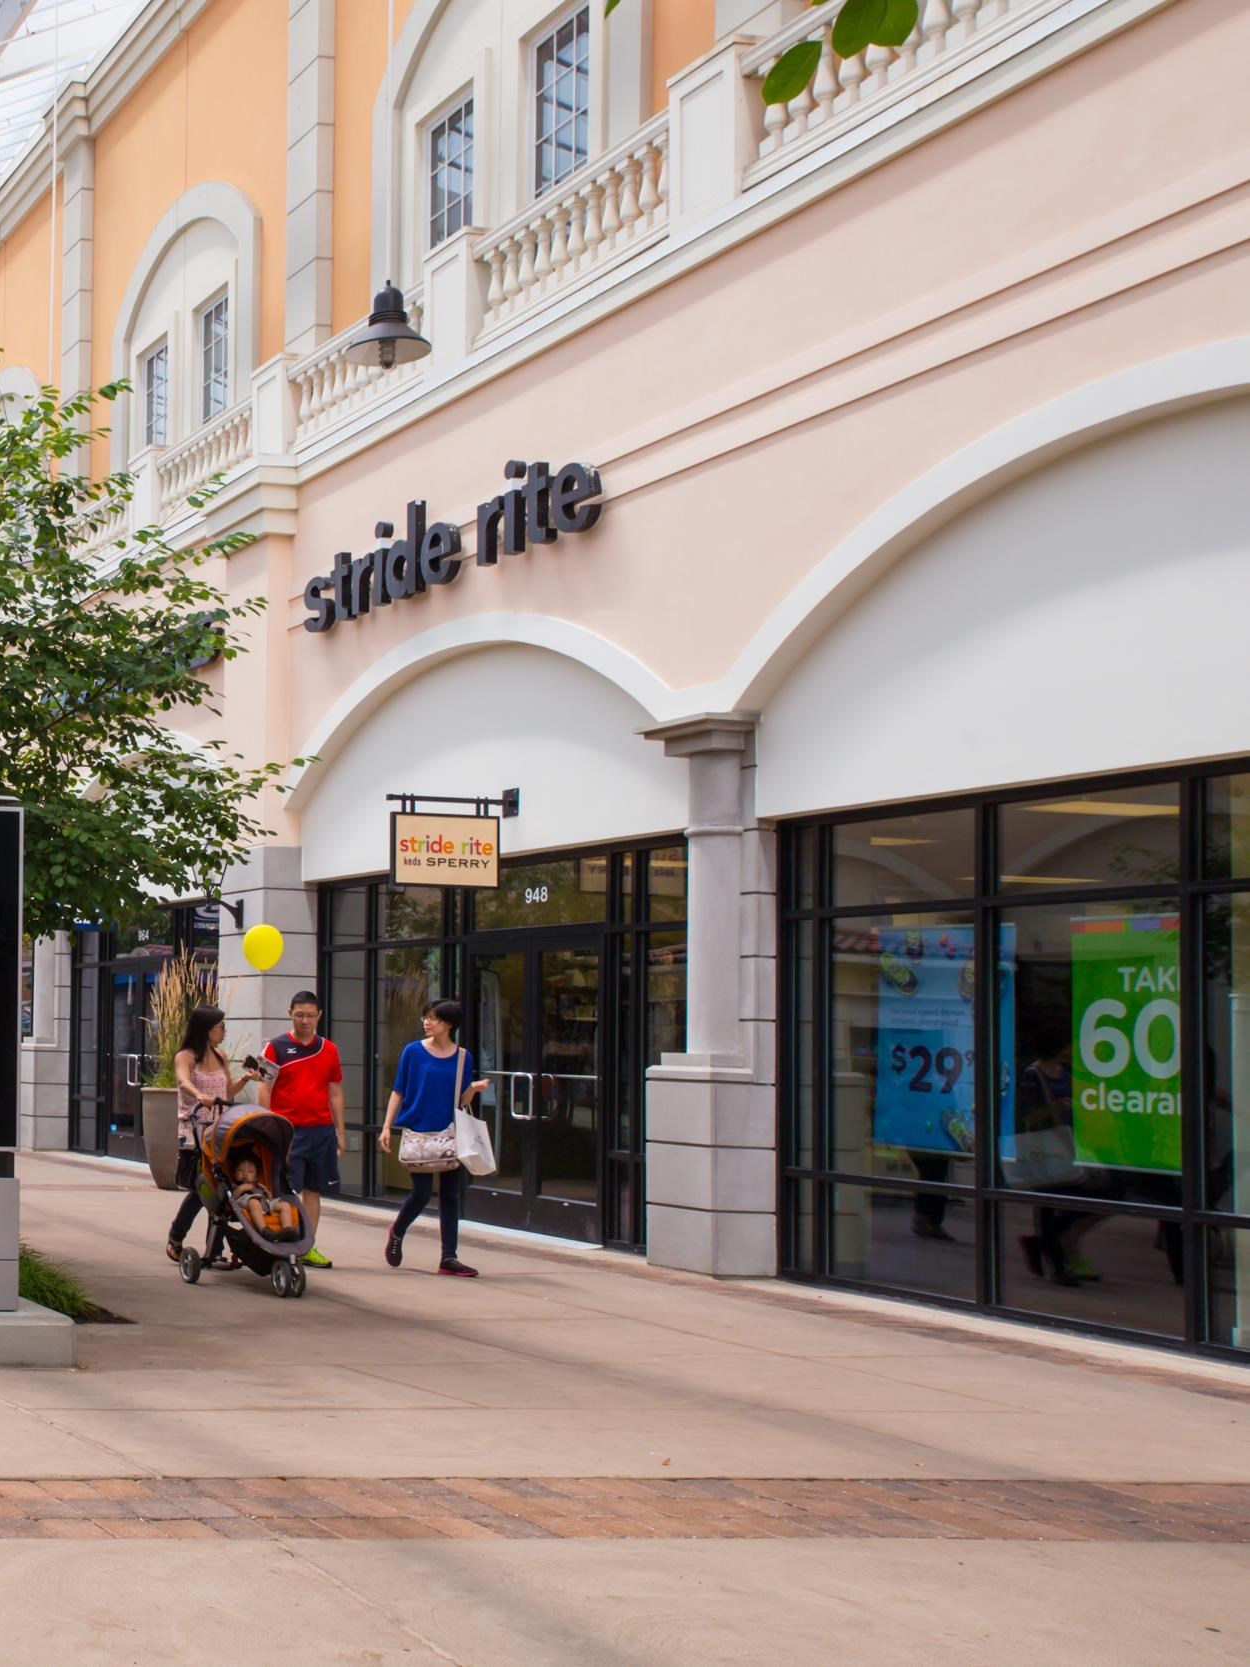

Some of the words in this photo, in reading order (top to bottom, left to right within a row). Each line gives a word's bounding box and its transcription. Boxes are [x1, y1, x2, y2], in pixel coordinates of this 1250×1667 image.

[303, 500, 462, 633] stride
[477, 460, 603, 567] rite
[399, 834, 455, 855] stride
[461, 837, 494, 856] rite
[403, 856, 421, 866] keds
[426, 857, 490, 869] SPERRY
[525, 886, 549, 904] 948
[1117, 966, 1181, 993] TAK
[1079, 998, 1181, 1080] 60
